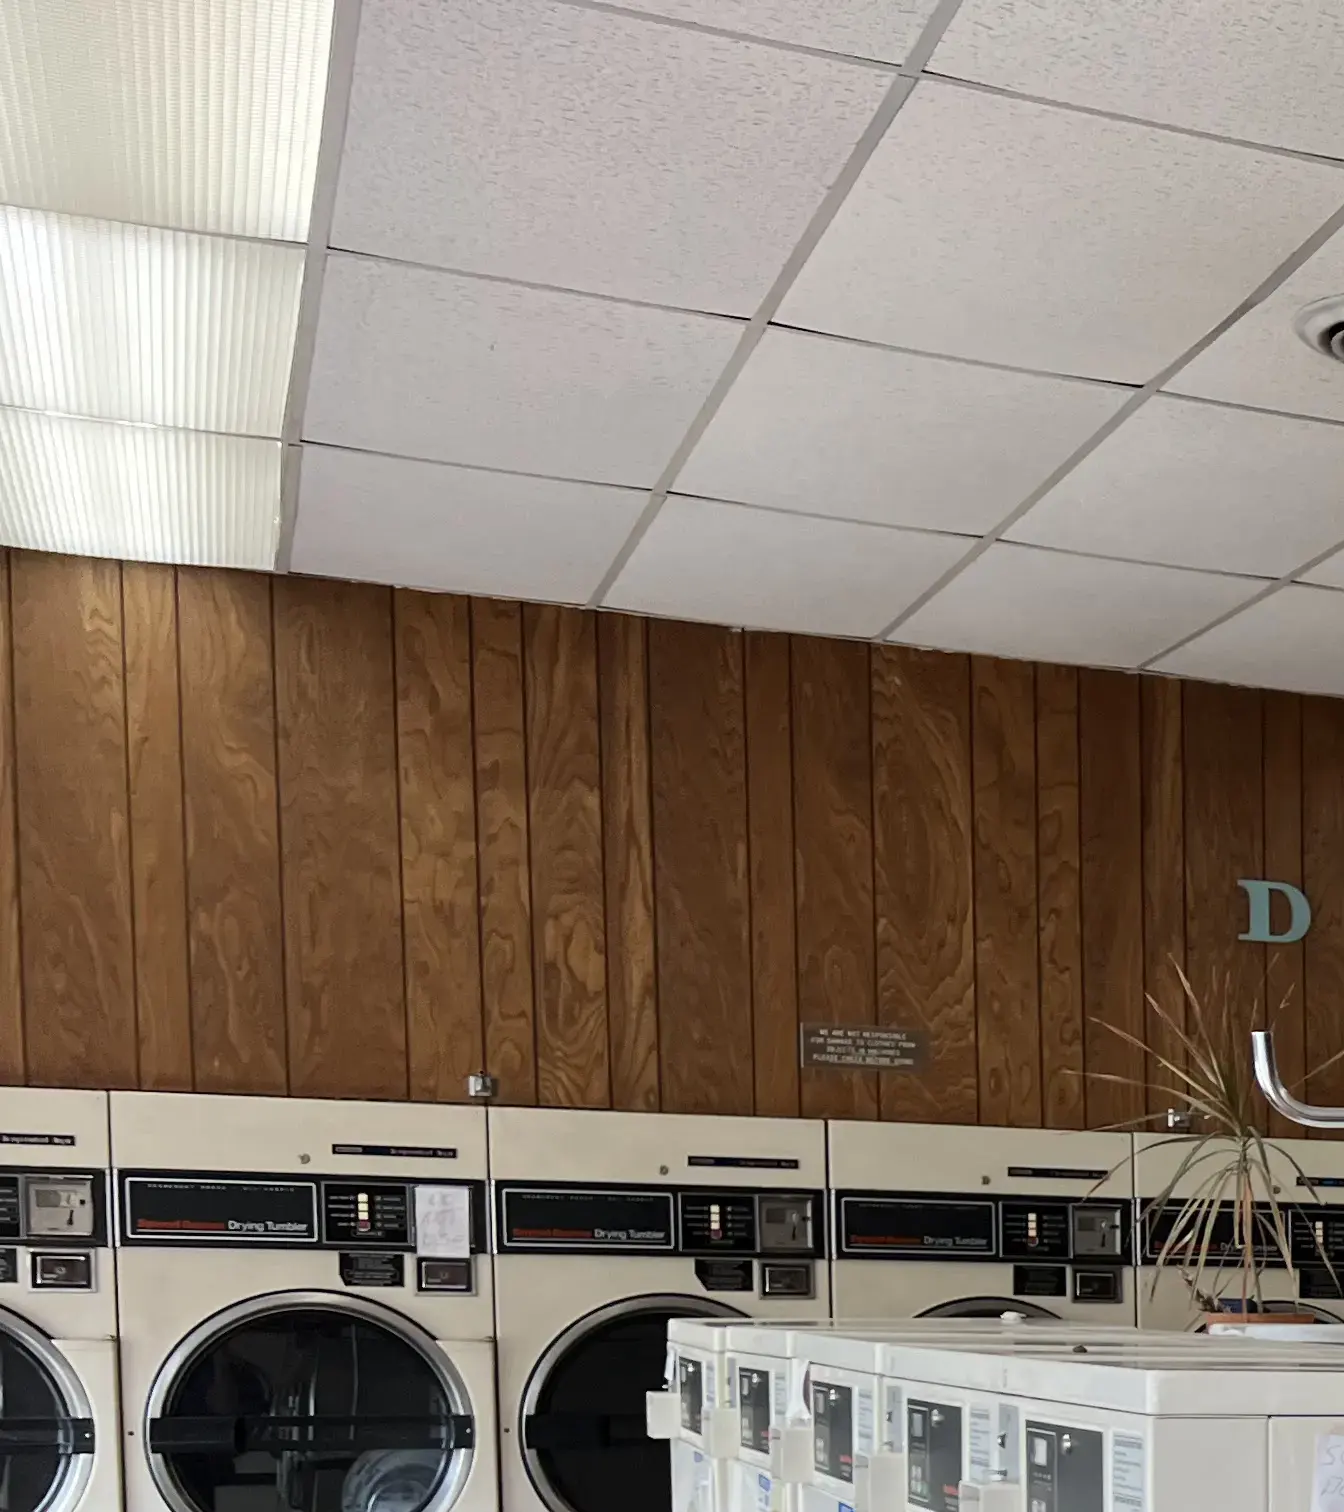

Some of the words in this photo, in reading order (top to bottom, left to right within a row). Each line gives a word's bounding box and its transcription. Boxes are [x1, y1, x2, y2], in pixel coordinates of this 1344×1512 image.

[227, 1219, 265, 1233] Drying
[266, 1220, 308, 1233] Tumbler
[594, 1228, 627, 1241] Drying
